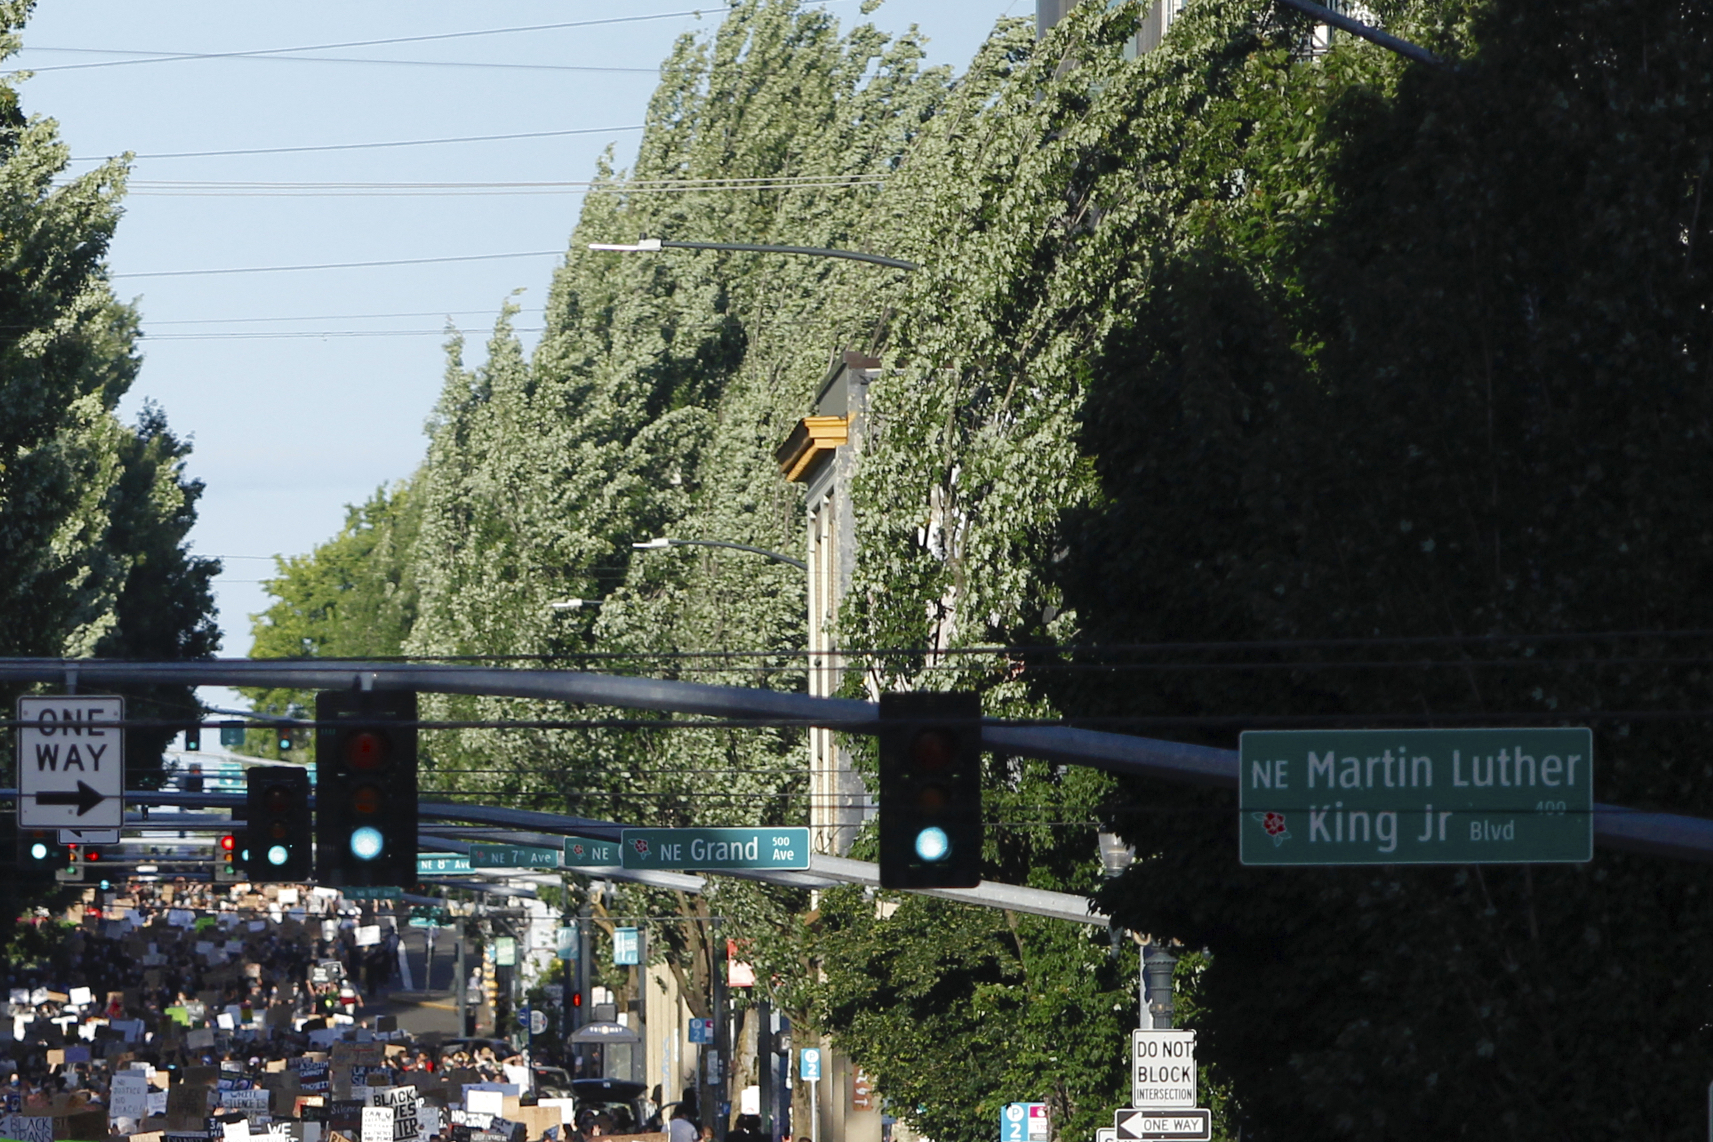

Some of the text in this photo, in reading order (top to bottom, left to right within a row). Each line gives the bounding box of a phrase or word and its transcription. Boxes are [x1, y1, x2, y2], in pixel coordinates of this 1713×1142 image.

[38, 708, 105, 738] ONE
[35, 743, 107, 773] WAY
[1251, 746, 1581, 788] NE Martin Luther
[1309, 802, 1398, 852] King
[1470, 820, 1515, 841] Blvd
[660, 837, 794, 861] NE Grand Ave
[772, 837, 790, 847] 500
[491, 852, 505, 864] NE
[531, 851, 551, 863] Ave
[592, 847, 609, 860] NE
[421, 860, 433, 870] NE
[1137, 1041, 1194, 1058] DO NOT
[807, 1063, 817, 1075] 2
[1138, 1066, 1191, 1083] BLOCK
[373, 1088, 415, 1107] BLACK
[1136, 1088, 1192, 1100] INTERSECTION
[11, 1118, 51, 1131] BLACK
[267, 1122, 292, 1134] WE
[1009, 1123, 1022, 1139] 2
[1143, 1119, 1199, 1131] ONE WAY
